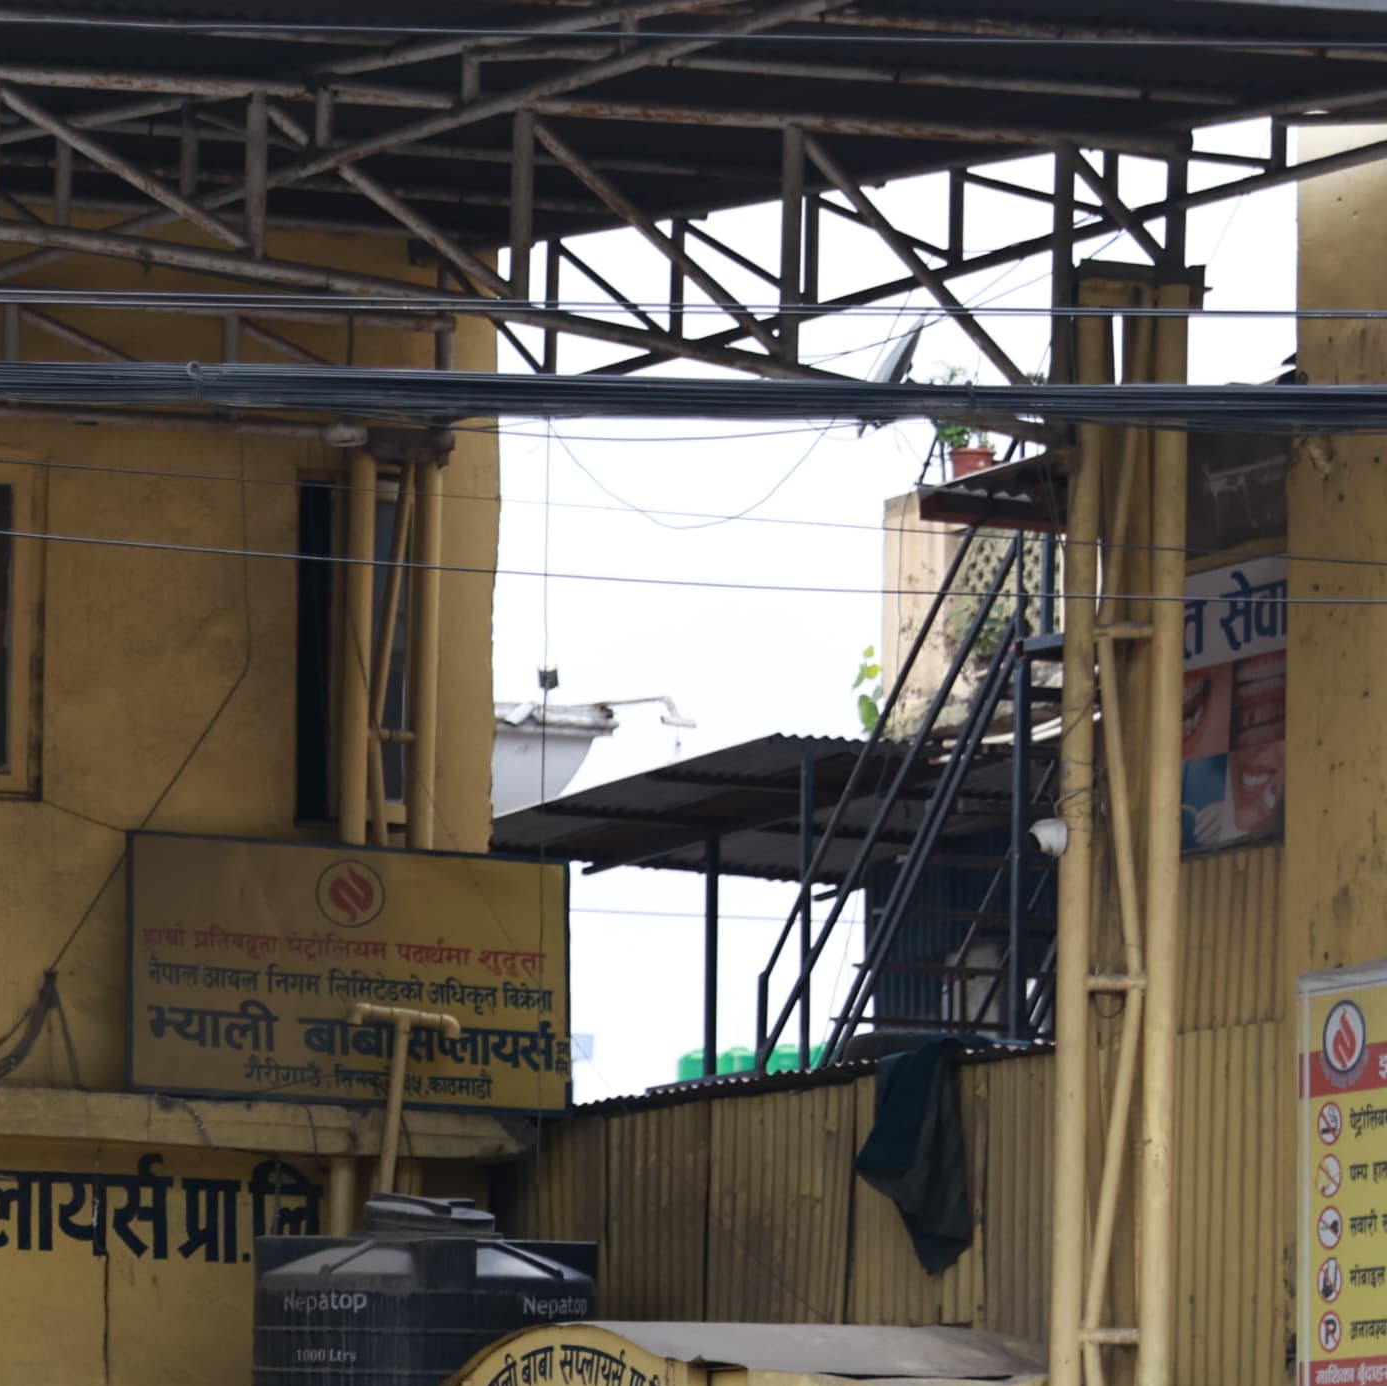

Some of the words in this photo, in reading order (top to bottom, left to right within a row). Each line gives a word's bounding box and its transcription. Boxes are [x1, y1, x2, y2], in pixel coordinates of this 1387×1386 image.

[266, 964, 322, 995] निगम
[283, 1291, 368, 1314] Nepatop
[522, 1295, 588, 1317] Nepatop
